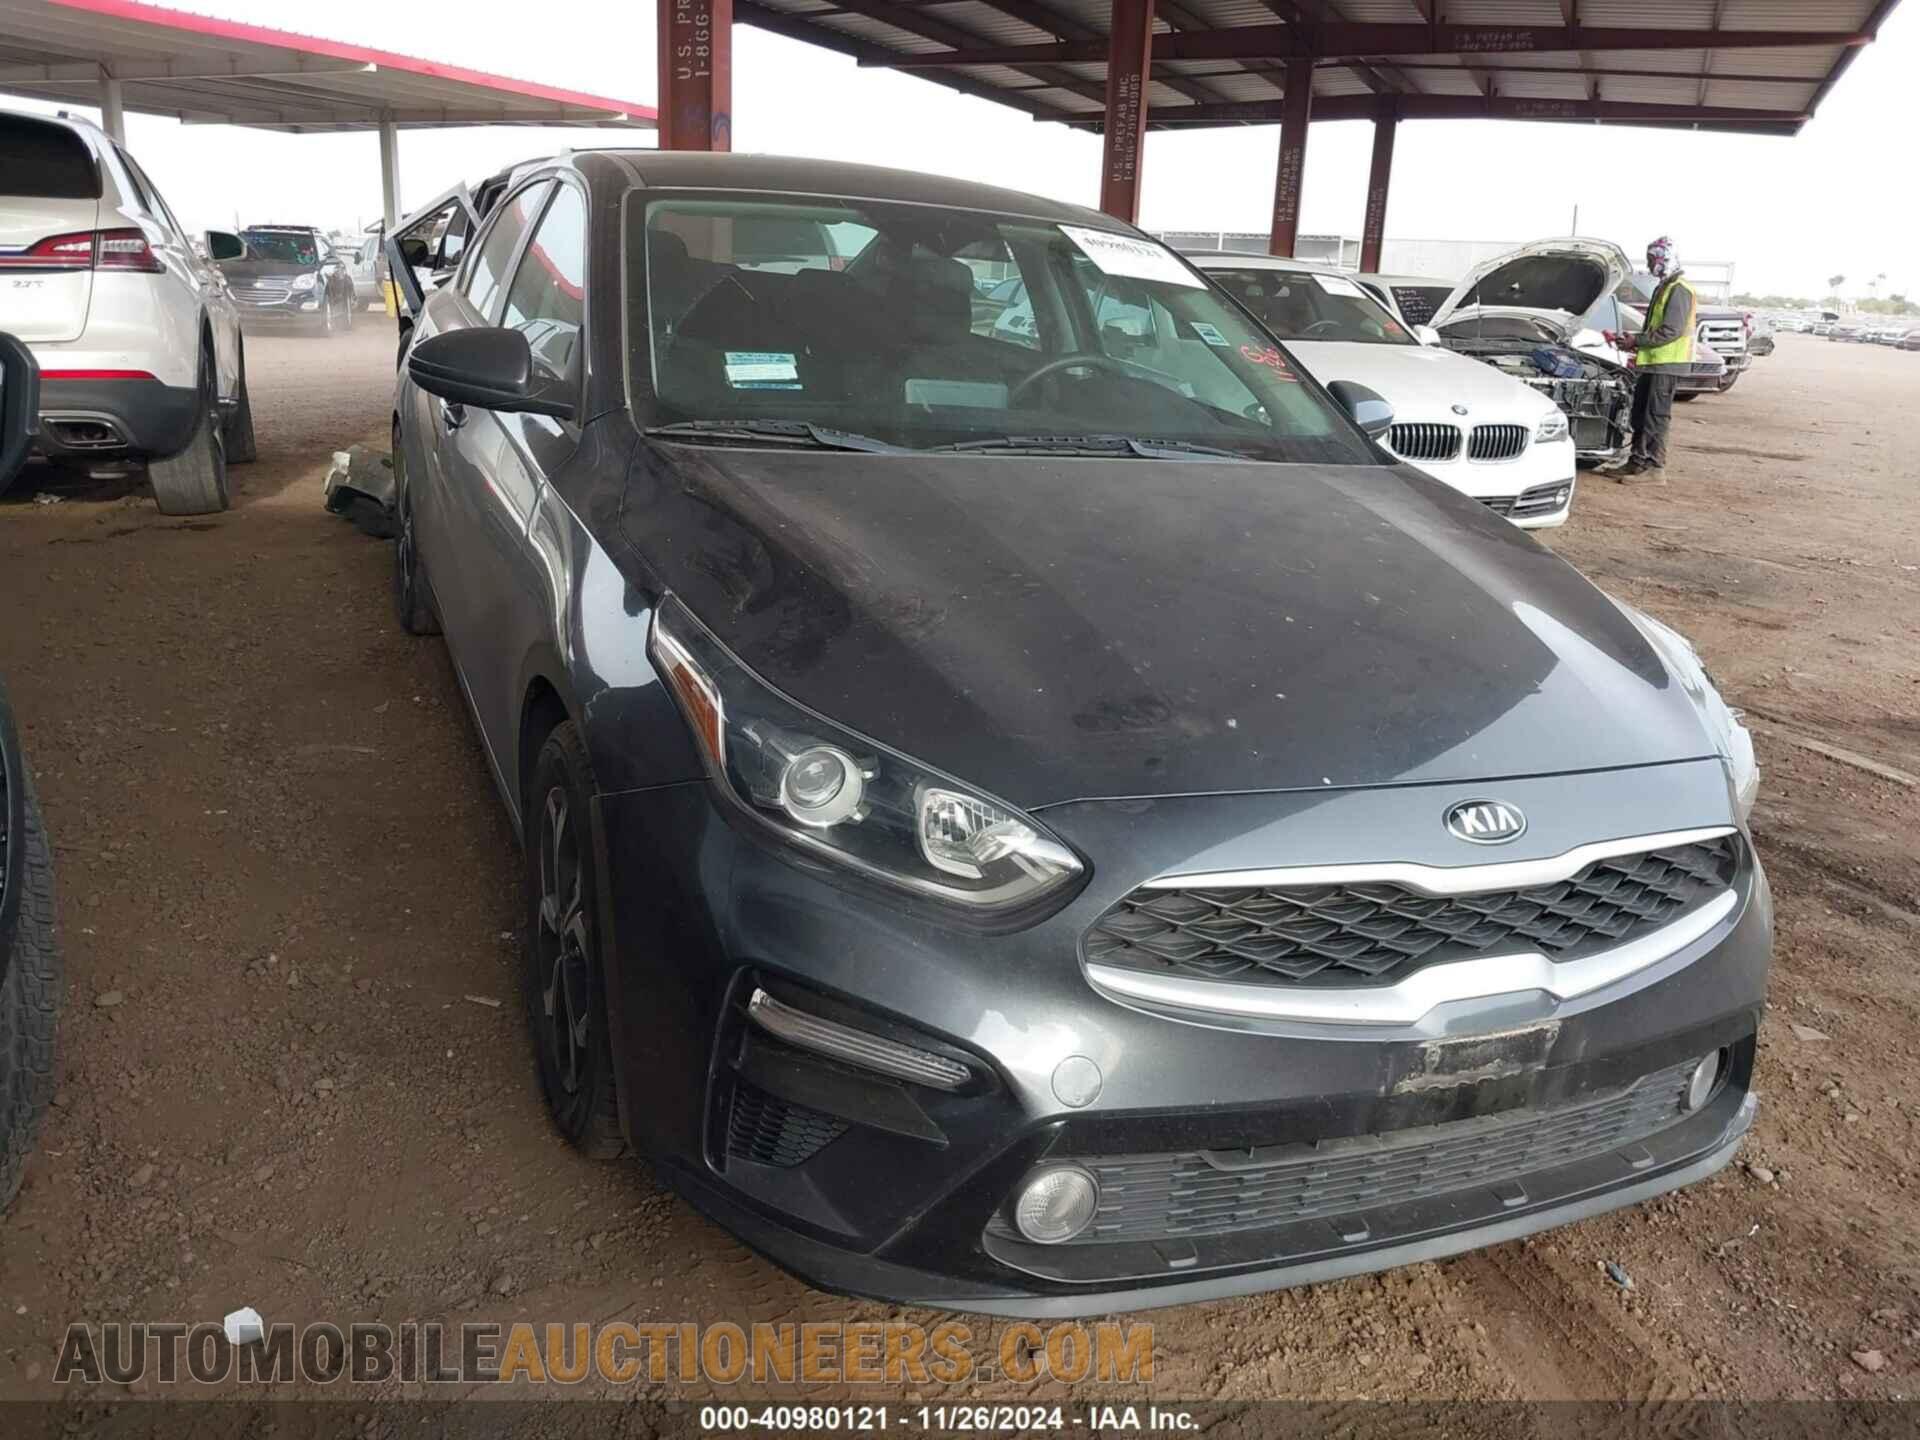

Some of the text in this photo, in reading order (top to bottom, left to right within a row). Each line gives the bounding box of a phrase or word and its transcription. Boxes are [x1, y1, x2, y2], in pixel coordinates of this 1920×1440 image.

[677, 36, 692, 80] U.S.
[1114, 103, 1128, 152] PREFAB
[1456, 806, 1520, 834] KIA
